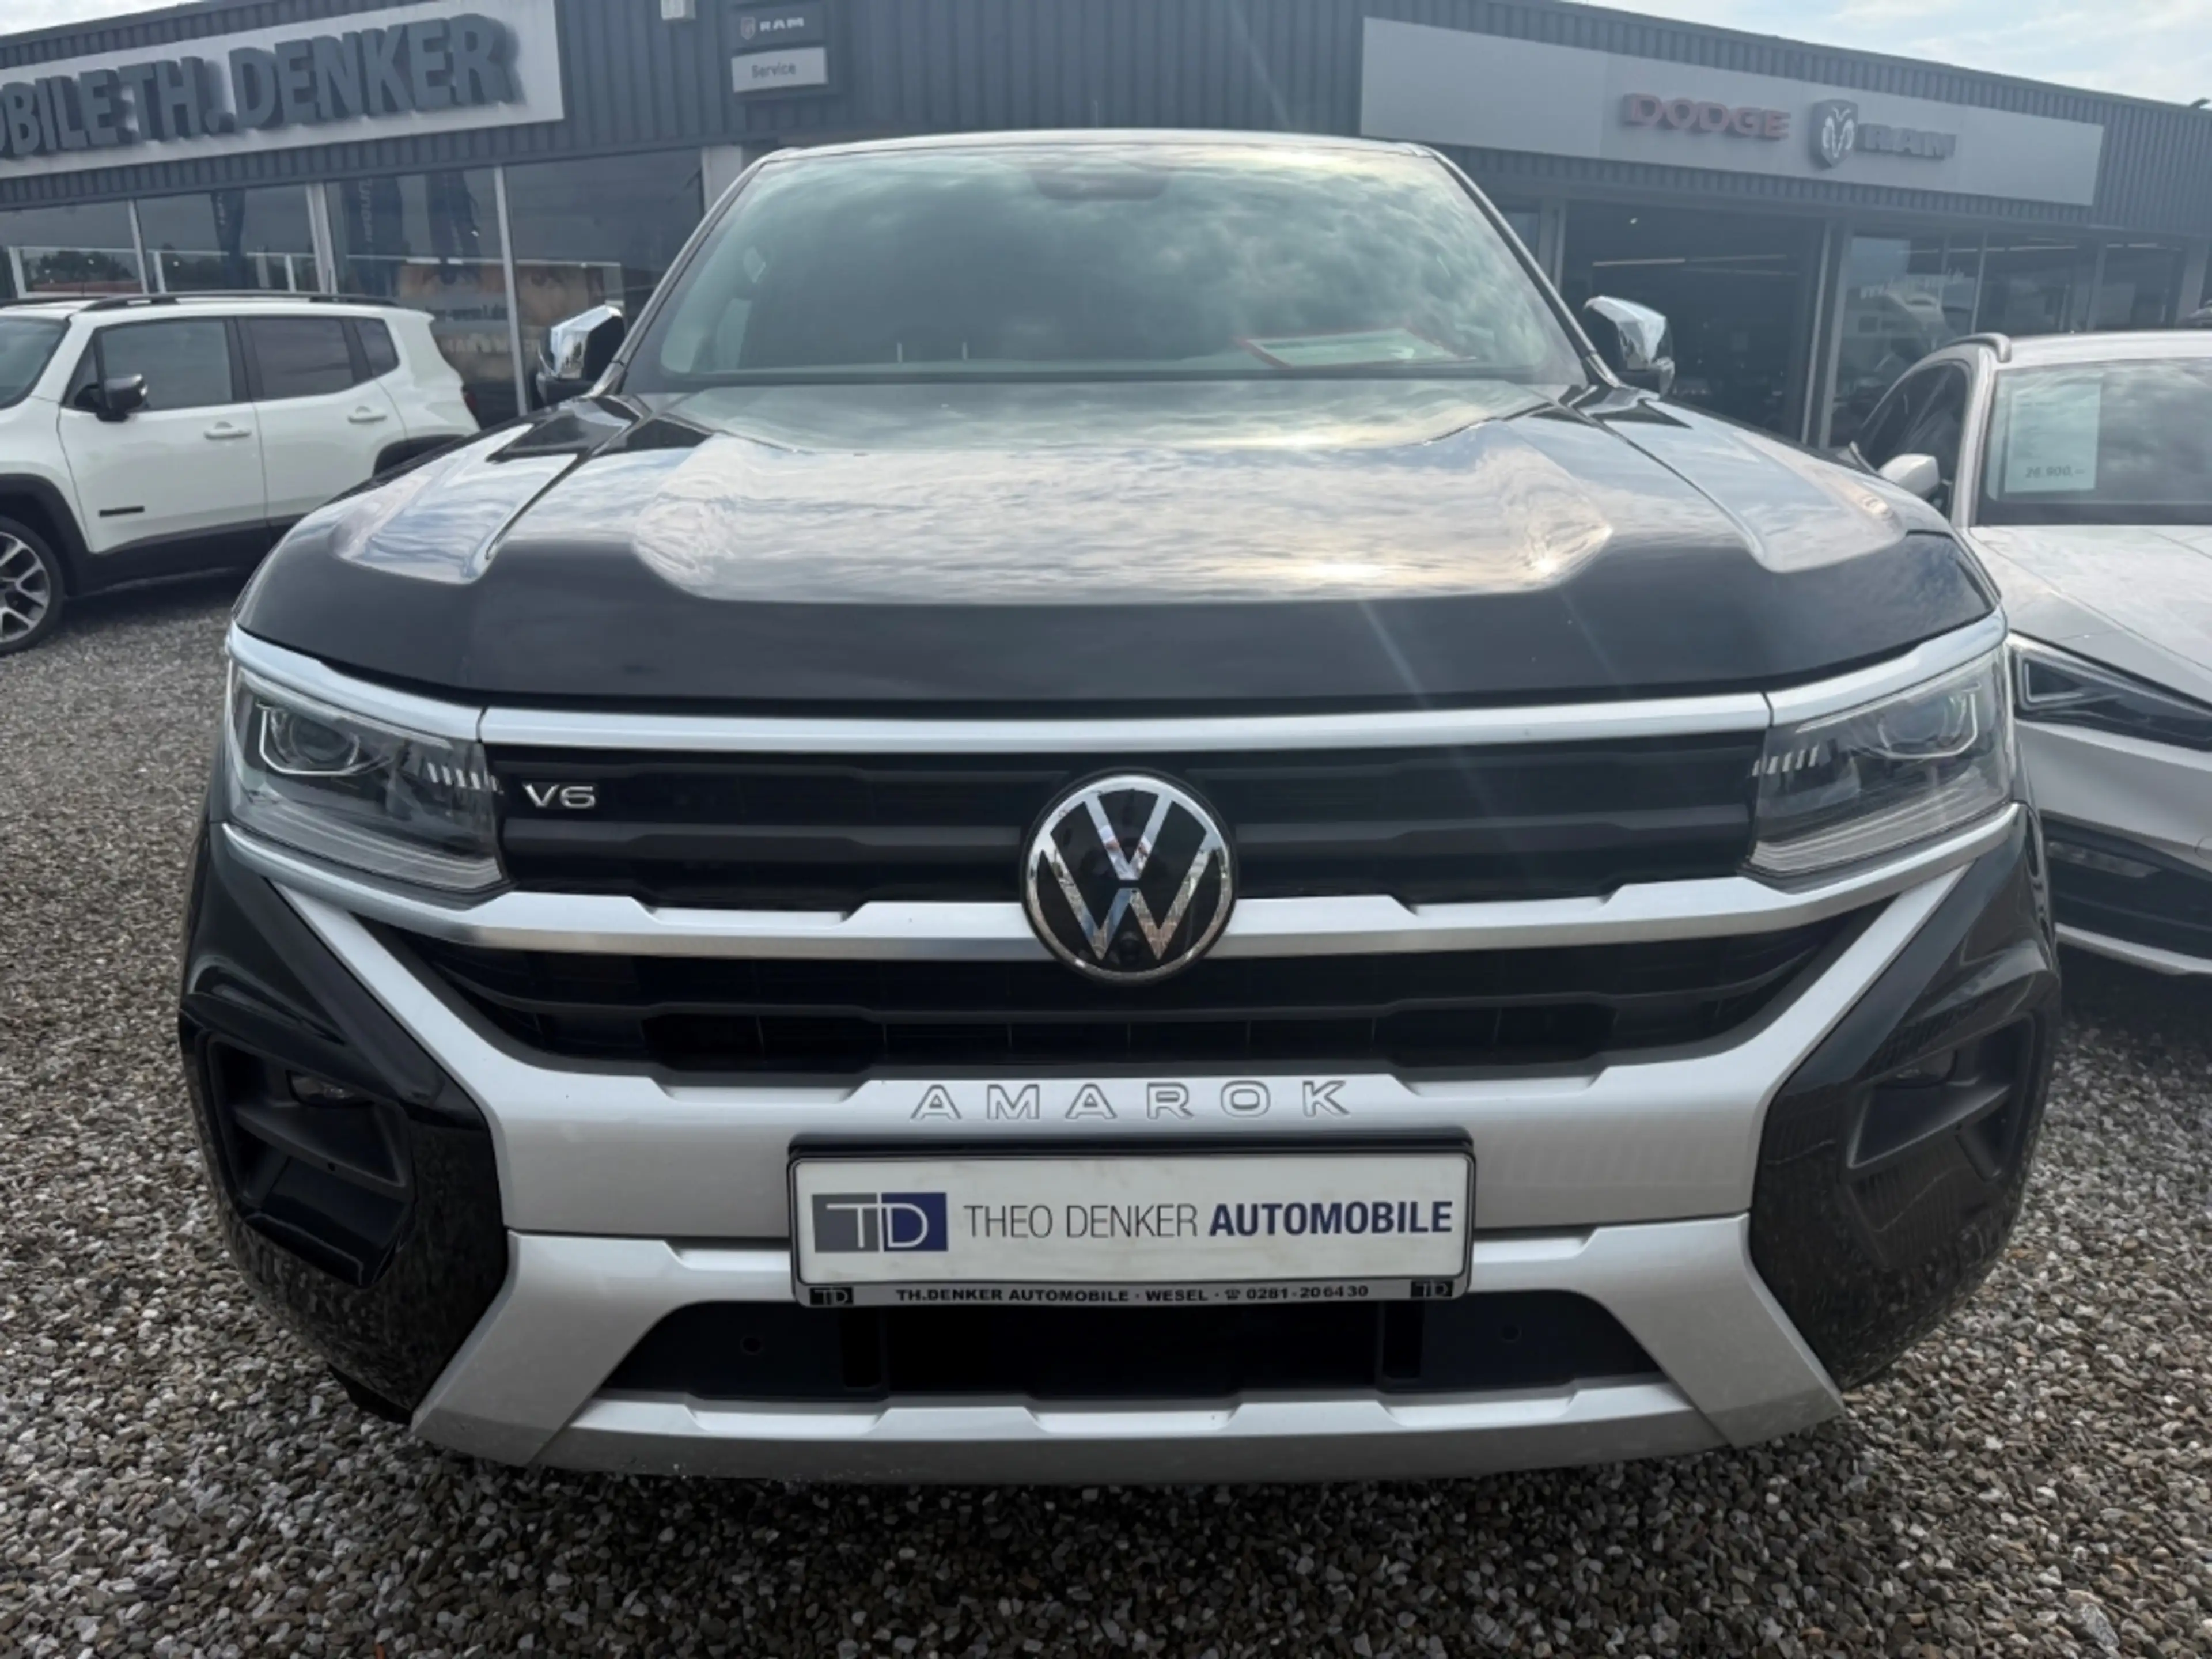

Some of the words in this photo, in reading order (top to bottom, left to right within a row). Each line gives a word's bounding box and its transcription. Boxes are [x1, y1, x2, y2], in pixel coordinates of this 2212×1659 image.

[759, 17, 804, 32] RAM
[751, 62, 796, 79] Service
[0, 69, 121, 157] BILE
[1623, 93, 1791, 140] DODGE
[1858, 122, 1957, 160] RAM
[522, 783, 597, 809] V6
[909, 1080, 1350, 1120] AMAROK
[963, 1205, 1053, 1238] THEO
[1066, 1203, 1198, 1238] DENKER
[1208, 1200, 1453, 1237] AUTOMOBILE
[1008, 1289, 1129, 1302] AUTOMOBILE
[1145, 1289, 1209, 1302] WESEL
